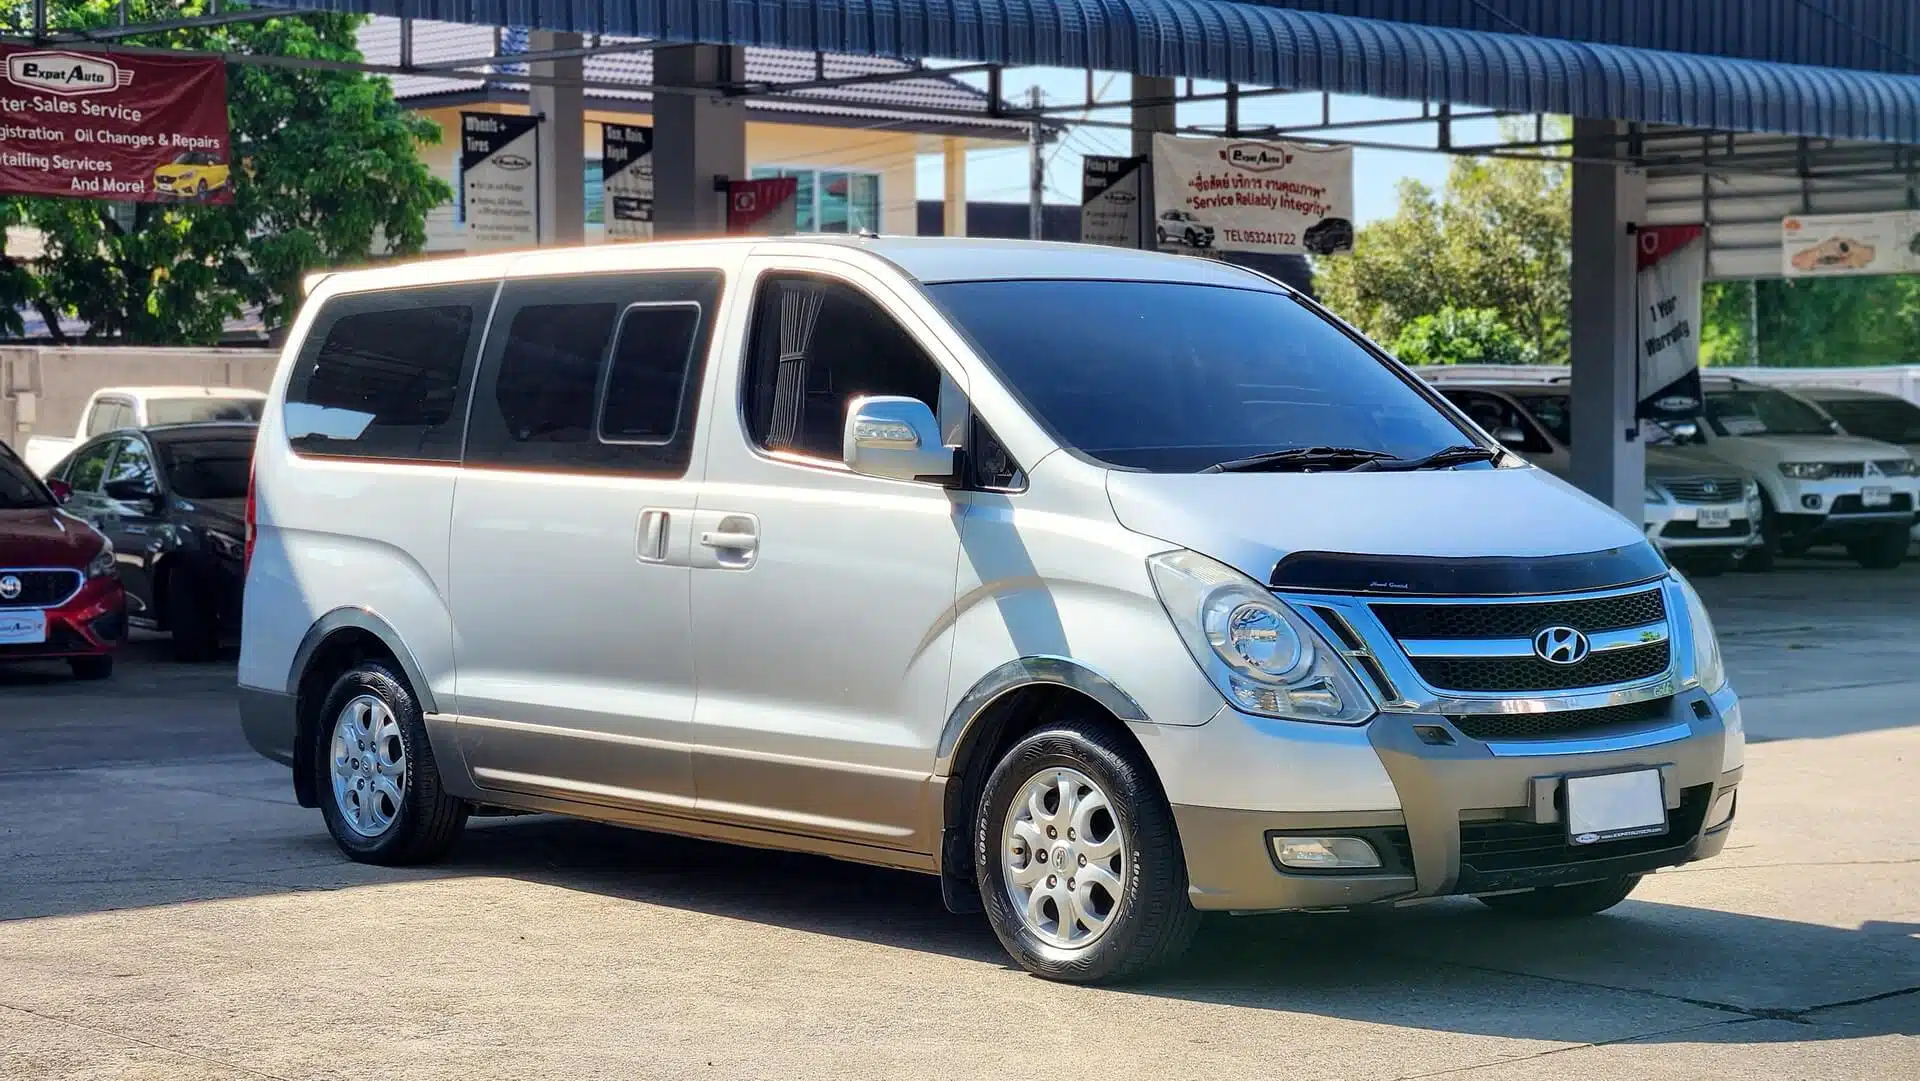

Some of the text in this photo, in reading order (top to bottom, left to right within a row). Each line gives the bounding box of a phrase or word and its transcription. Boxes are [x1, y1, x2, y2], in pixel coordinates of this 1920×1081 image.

[0, 96, 142, 122] ter-Sales Service
[465, 116, 498, 132] Wheels
[0, 124, 220, 150] gistration Oil Changes & Repairs
[466, 136, 490, 152] Tires
[0, 152, 113, 172] tailing Services
[71, 177, 145, 193] And More!
[1650, 295, 1677, 322] 1 Year
[1645, 320, 1690, 358] Warranty
